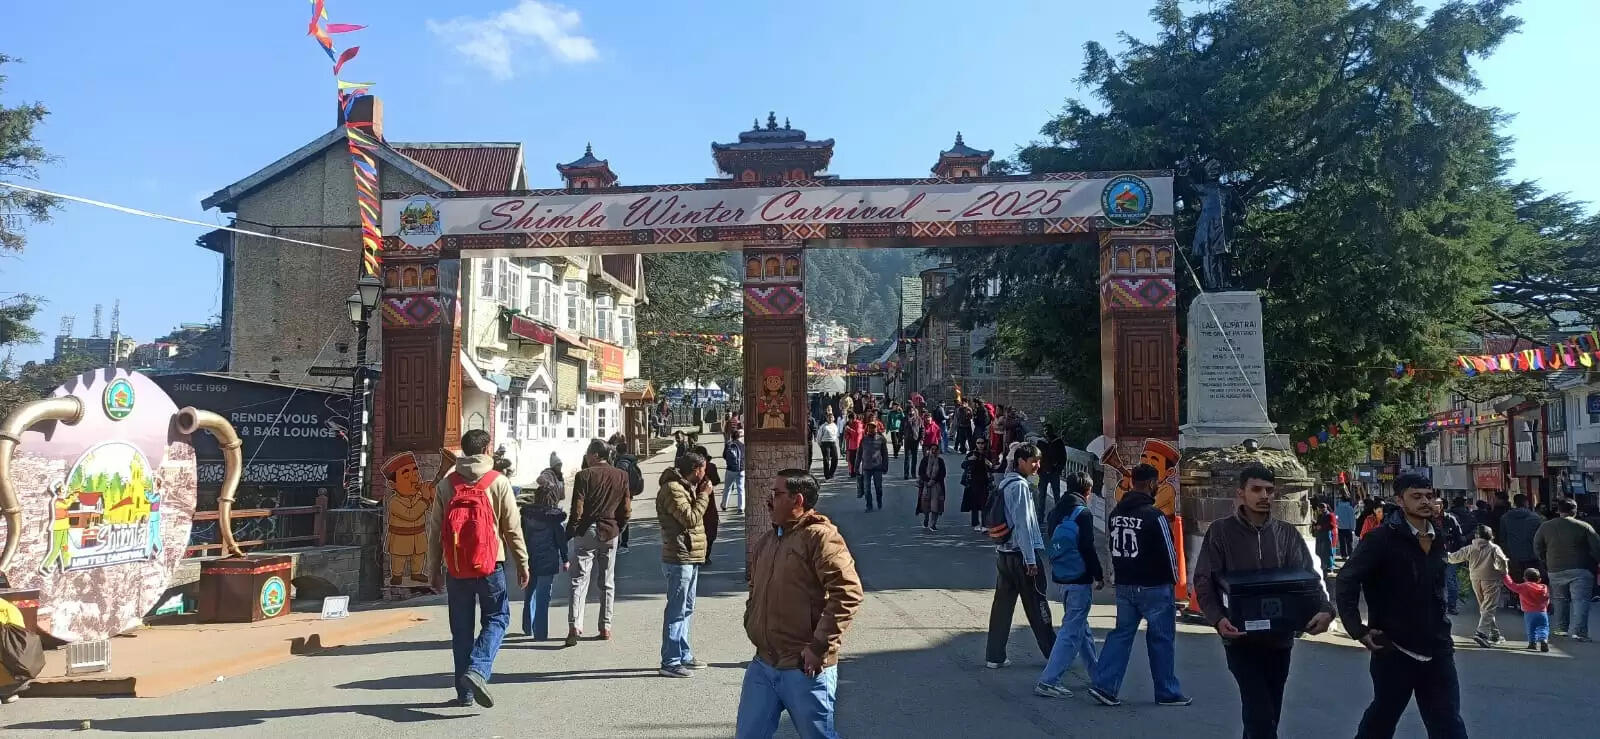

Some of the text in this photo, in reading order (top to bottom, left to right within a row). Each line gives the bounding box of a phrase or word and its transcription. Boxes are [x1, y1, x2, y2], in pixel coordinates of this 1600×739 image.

[479, 200, 608, 232] Shimla
[623, 195, 745, 227] Winter
[760, 190, 926, 223] Carnival
[963, 189, 1070, 217] 2025
[173, 383, 228, 393] SINCE 1969
[231, 412, 318, 425] RENDEZVOUS
[253, 427, 280, 437] BAR
[284, 427, 337, 438] LOUNGE
[96, 523, 147, 552] Shimla
[1110, 527, 1139, 558] 10
